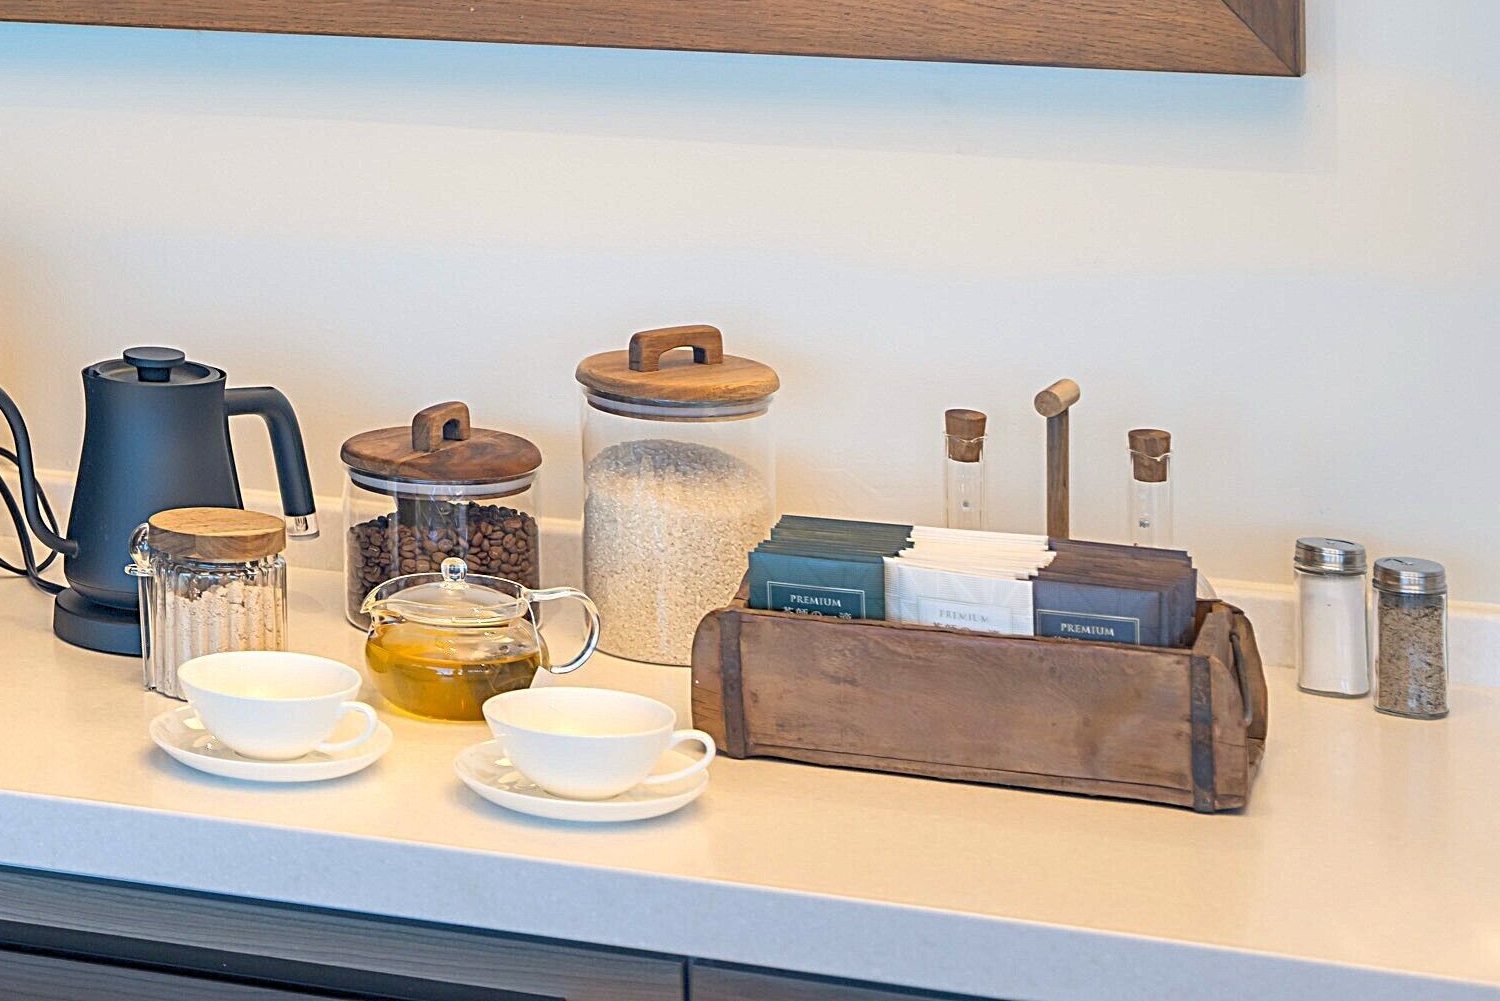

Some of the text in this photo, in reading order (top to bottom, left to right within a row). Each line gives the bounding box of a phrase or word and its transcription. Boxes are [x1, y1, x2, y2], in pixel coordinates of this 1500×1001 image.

[789, 594, 842, 607] PREMIUM
[939, 609, 989, 623] PREMIUM
[1060, 622, 1114, 637] PREMIUM
